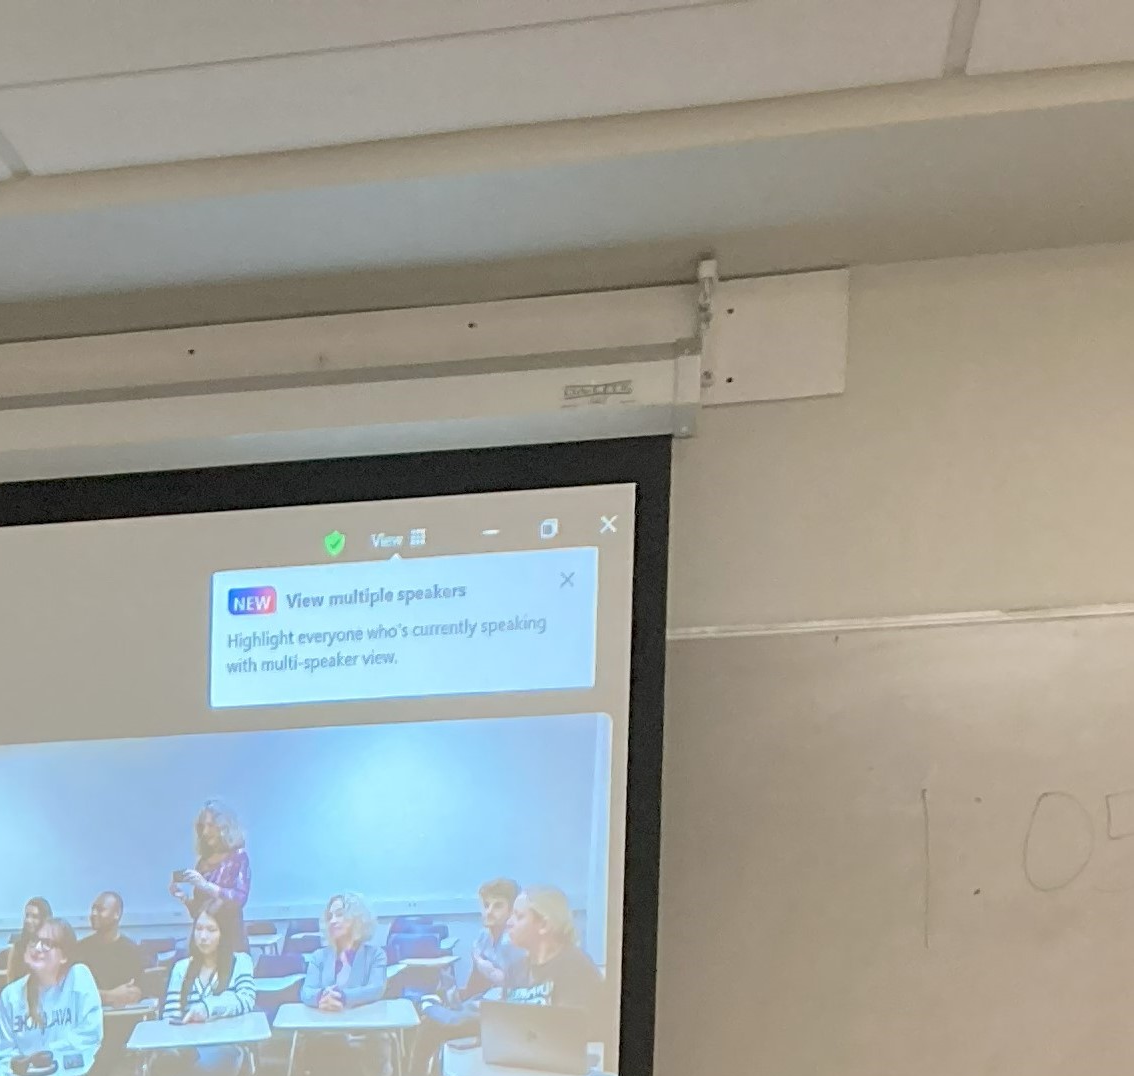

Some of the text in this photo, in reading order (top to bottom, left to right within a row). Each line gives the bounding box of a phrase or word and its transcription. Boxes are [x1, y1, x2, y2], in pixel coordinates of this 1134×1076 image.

[371, 532, 403, 548] View
[233, 583, 466, 612] NEW View multiple speakers
[227, 614, 547, 652] Highlight everyone who's currently speaking
[226, 650, 398, 674] with multi-speaker view.
